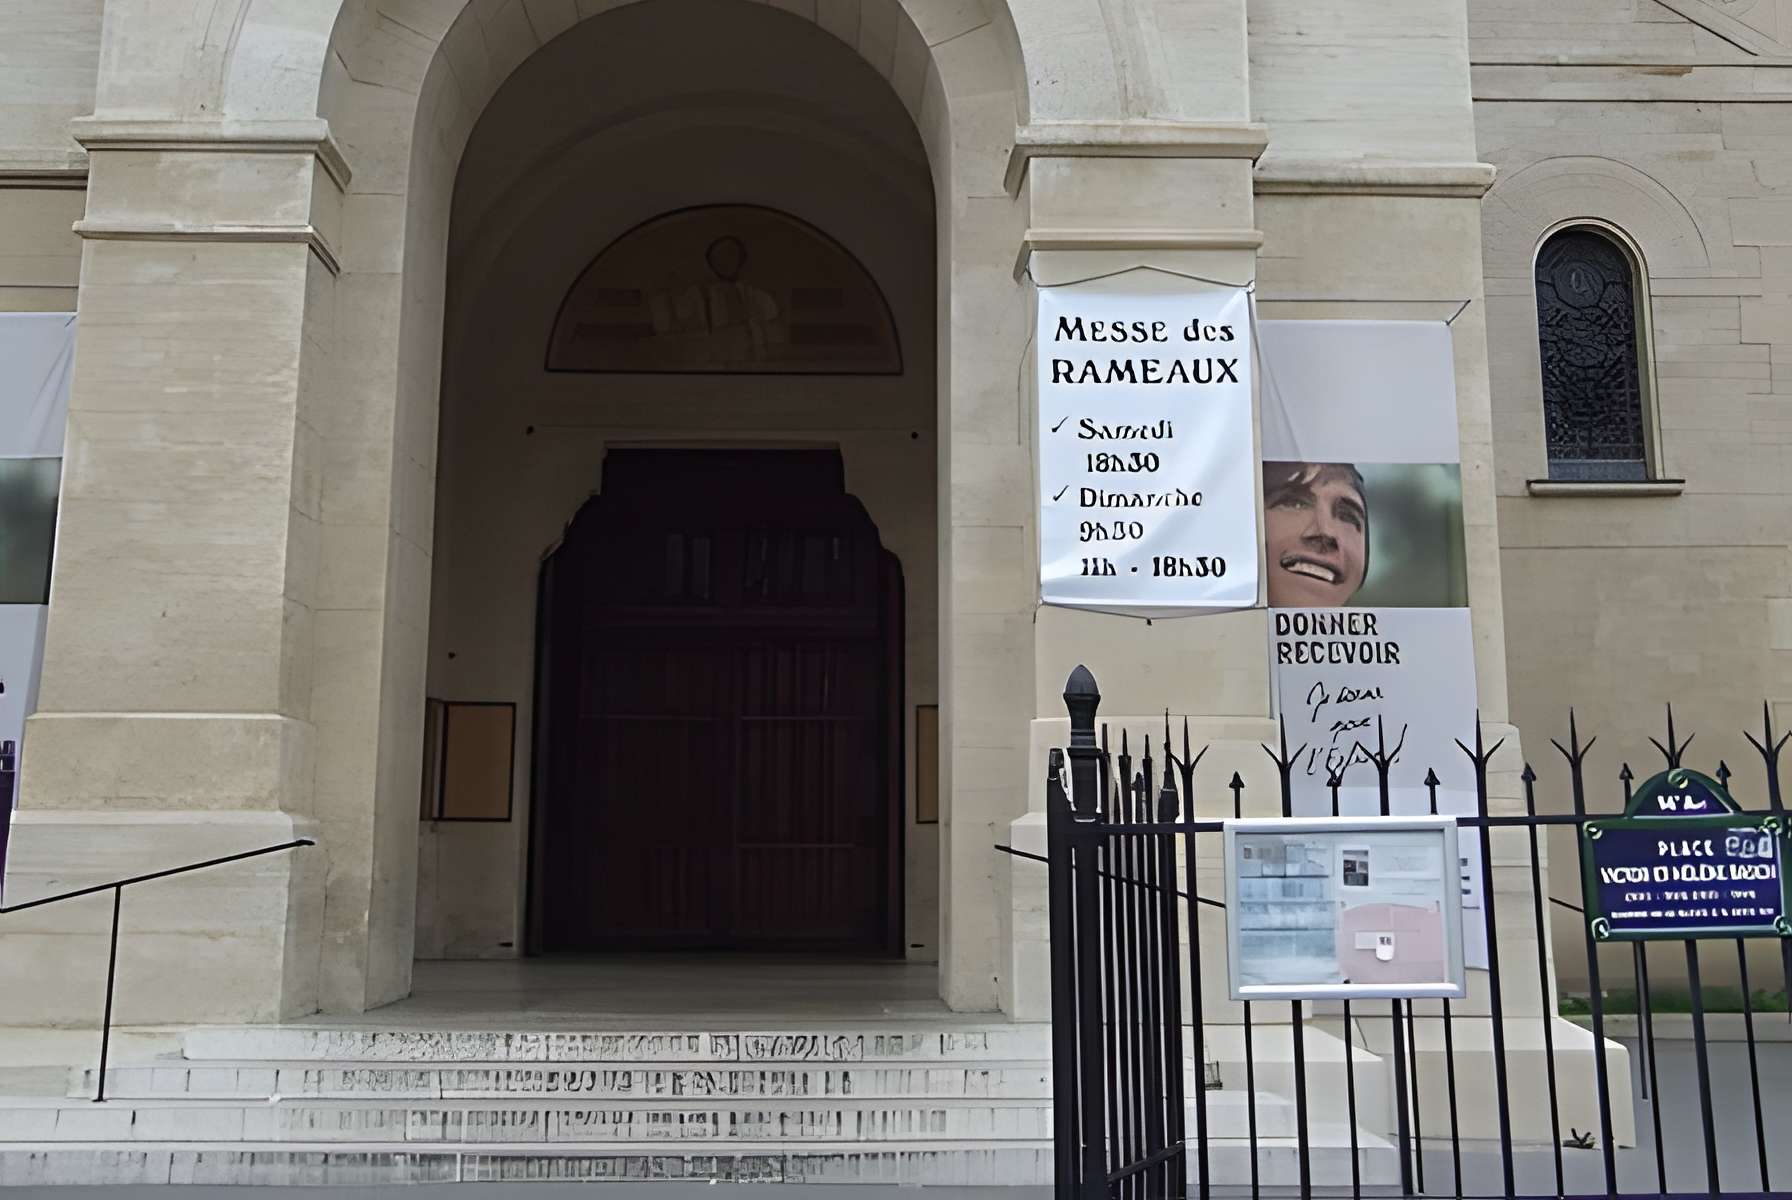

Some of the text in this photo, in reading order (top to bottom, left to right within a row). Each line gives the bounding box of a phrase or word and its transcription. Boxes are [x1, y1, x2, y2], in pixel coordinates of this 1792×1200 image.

[1183, 318, 1235, 342] des
[1052, 357, 1239, 384] RAMEAUX
[1152, 555, 1226, 578] 18h30
[1275, 612, 1379, 637] DONNER
[1276, 640, 1401, 665] RECEVOIR
